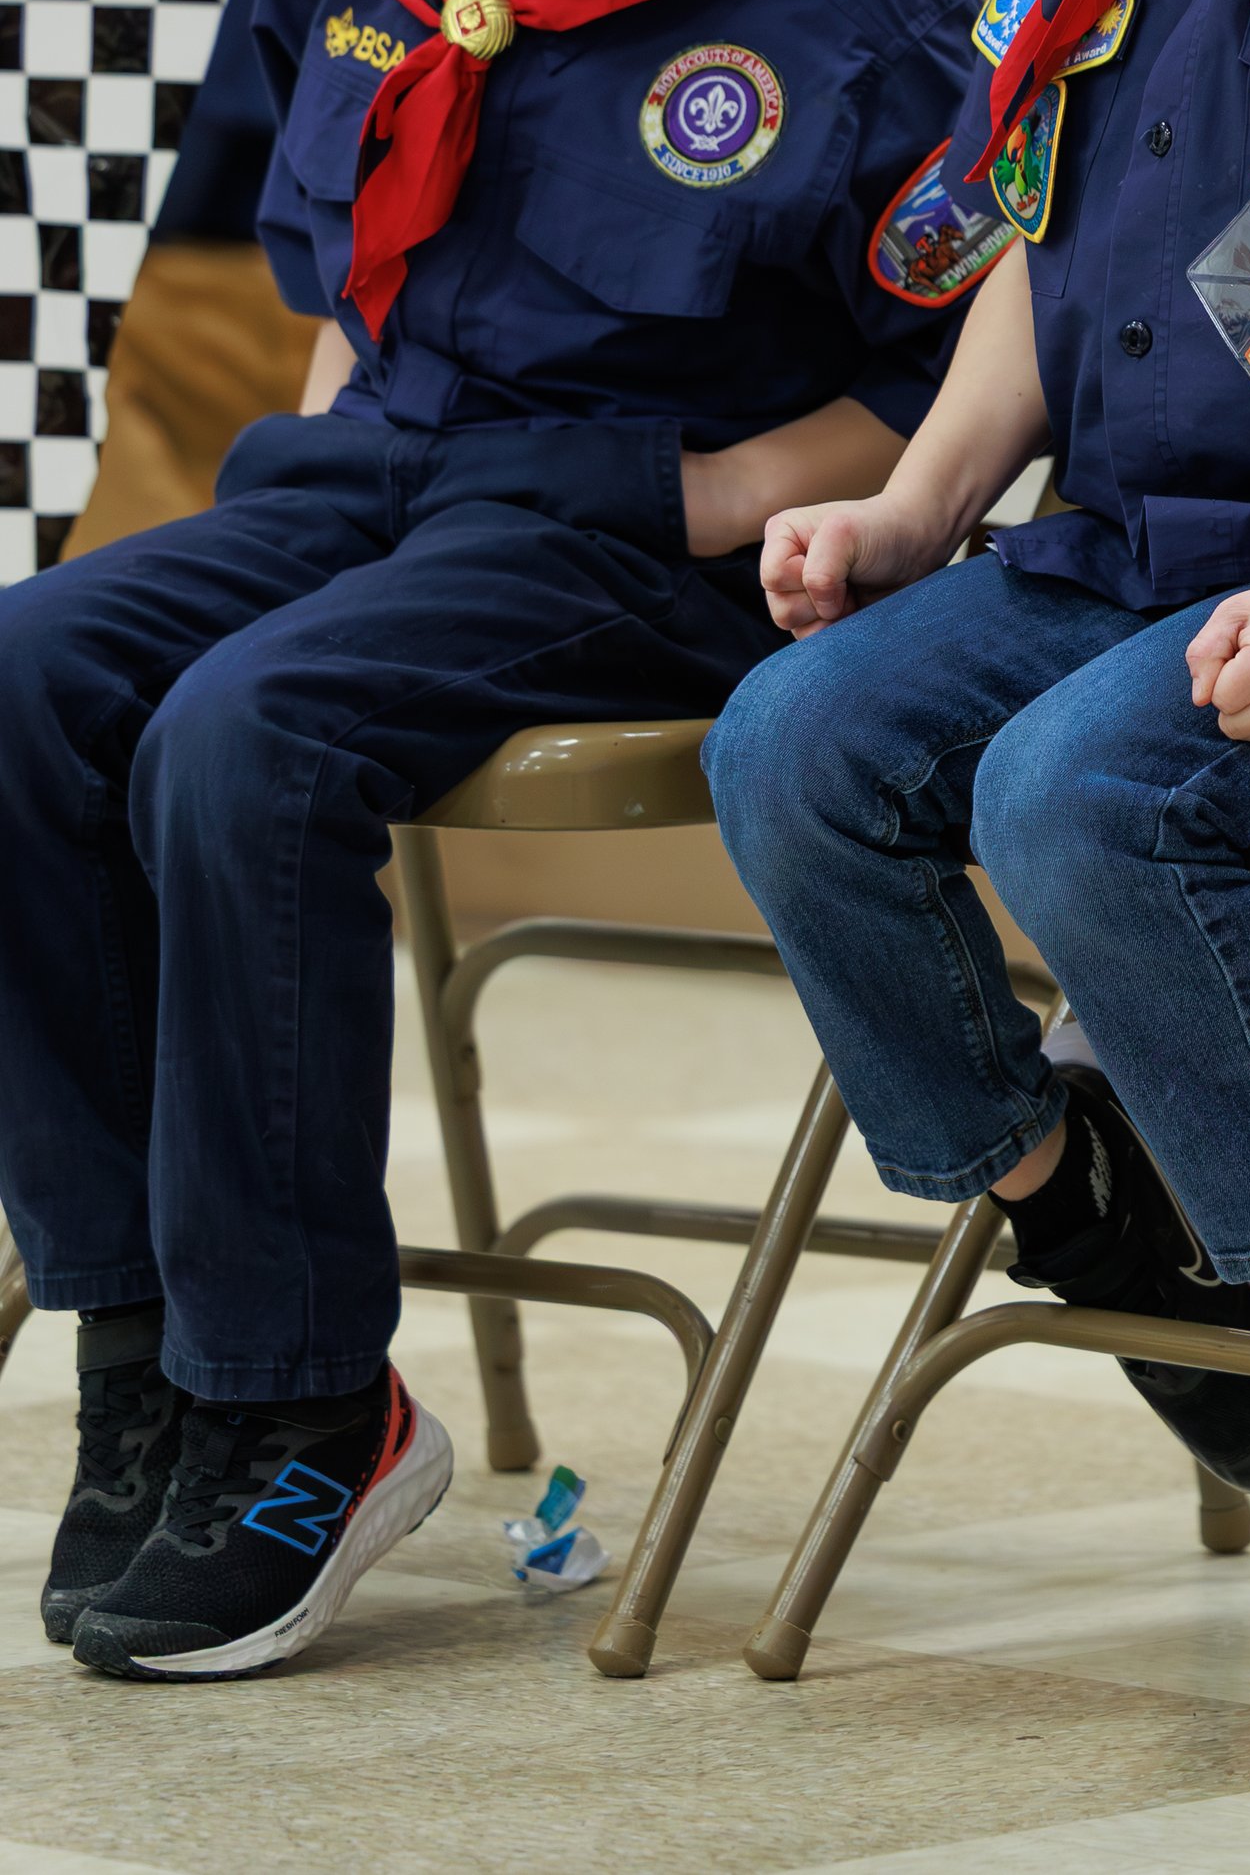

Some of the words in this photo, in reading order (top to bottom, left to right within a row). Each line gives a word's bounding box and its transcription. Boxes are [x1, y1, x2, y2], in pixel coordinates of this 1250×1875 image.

[352, 25, 405, 73] BSA
[1073, 43, 1107, 63] Award
[655, 67, 680, 96] BOY
[677, 49, 730, 73] SCOUTS
[743, 55, 778, 118] AMERICA
[662, 152, 701, 181] SINCE
[701, 164, 732, 181] 1910
[940, 250, 981, 285] TWIN
[242, 1460, 353, 1556] N
